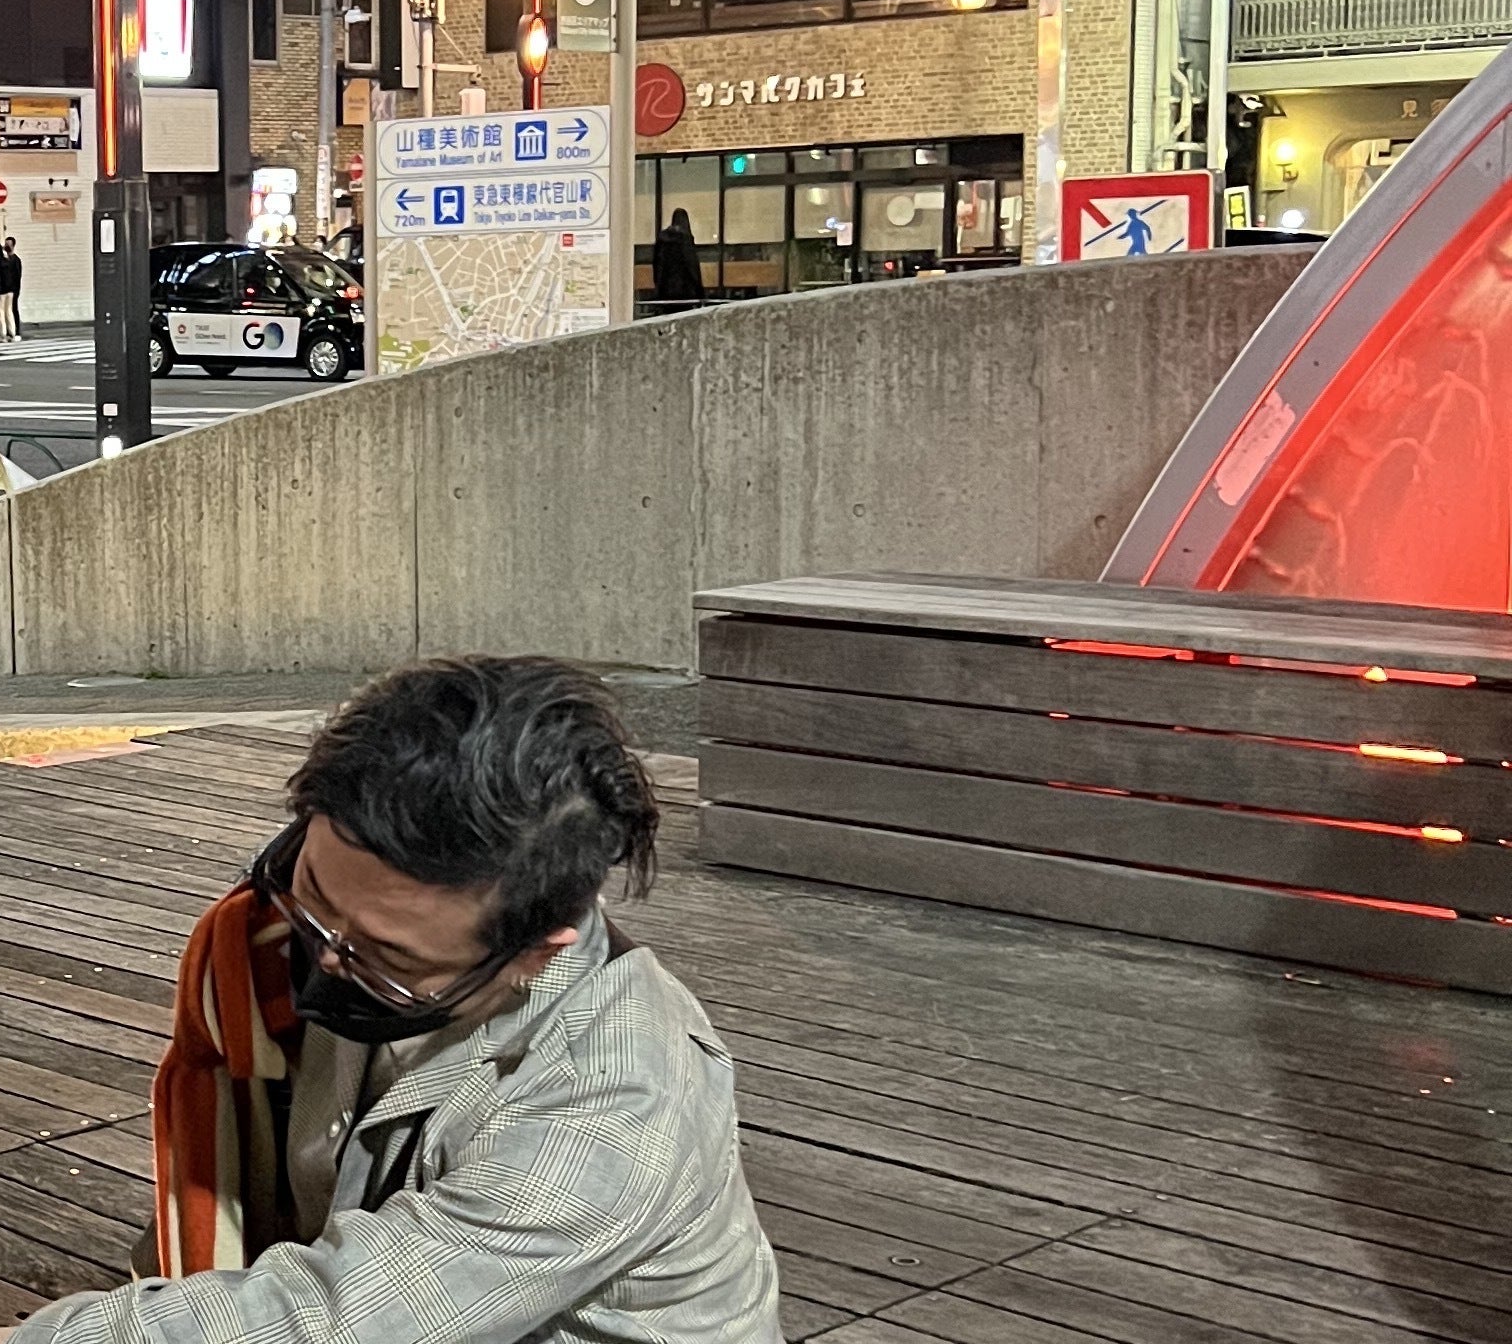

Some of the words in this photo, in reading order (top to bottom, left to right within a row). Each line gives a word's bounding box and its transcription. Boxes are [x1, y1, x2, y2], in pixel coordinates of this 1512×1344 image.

[396, 124, 503, 153] 山種美術館
[556, 147, 591, 160] 800m
[472, 178, 592, 207] 東急東横線代官山駅
[394, 215, 426, 227] 720m
[242, 320, 284, 350] GO
